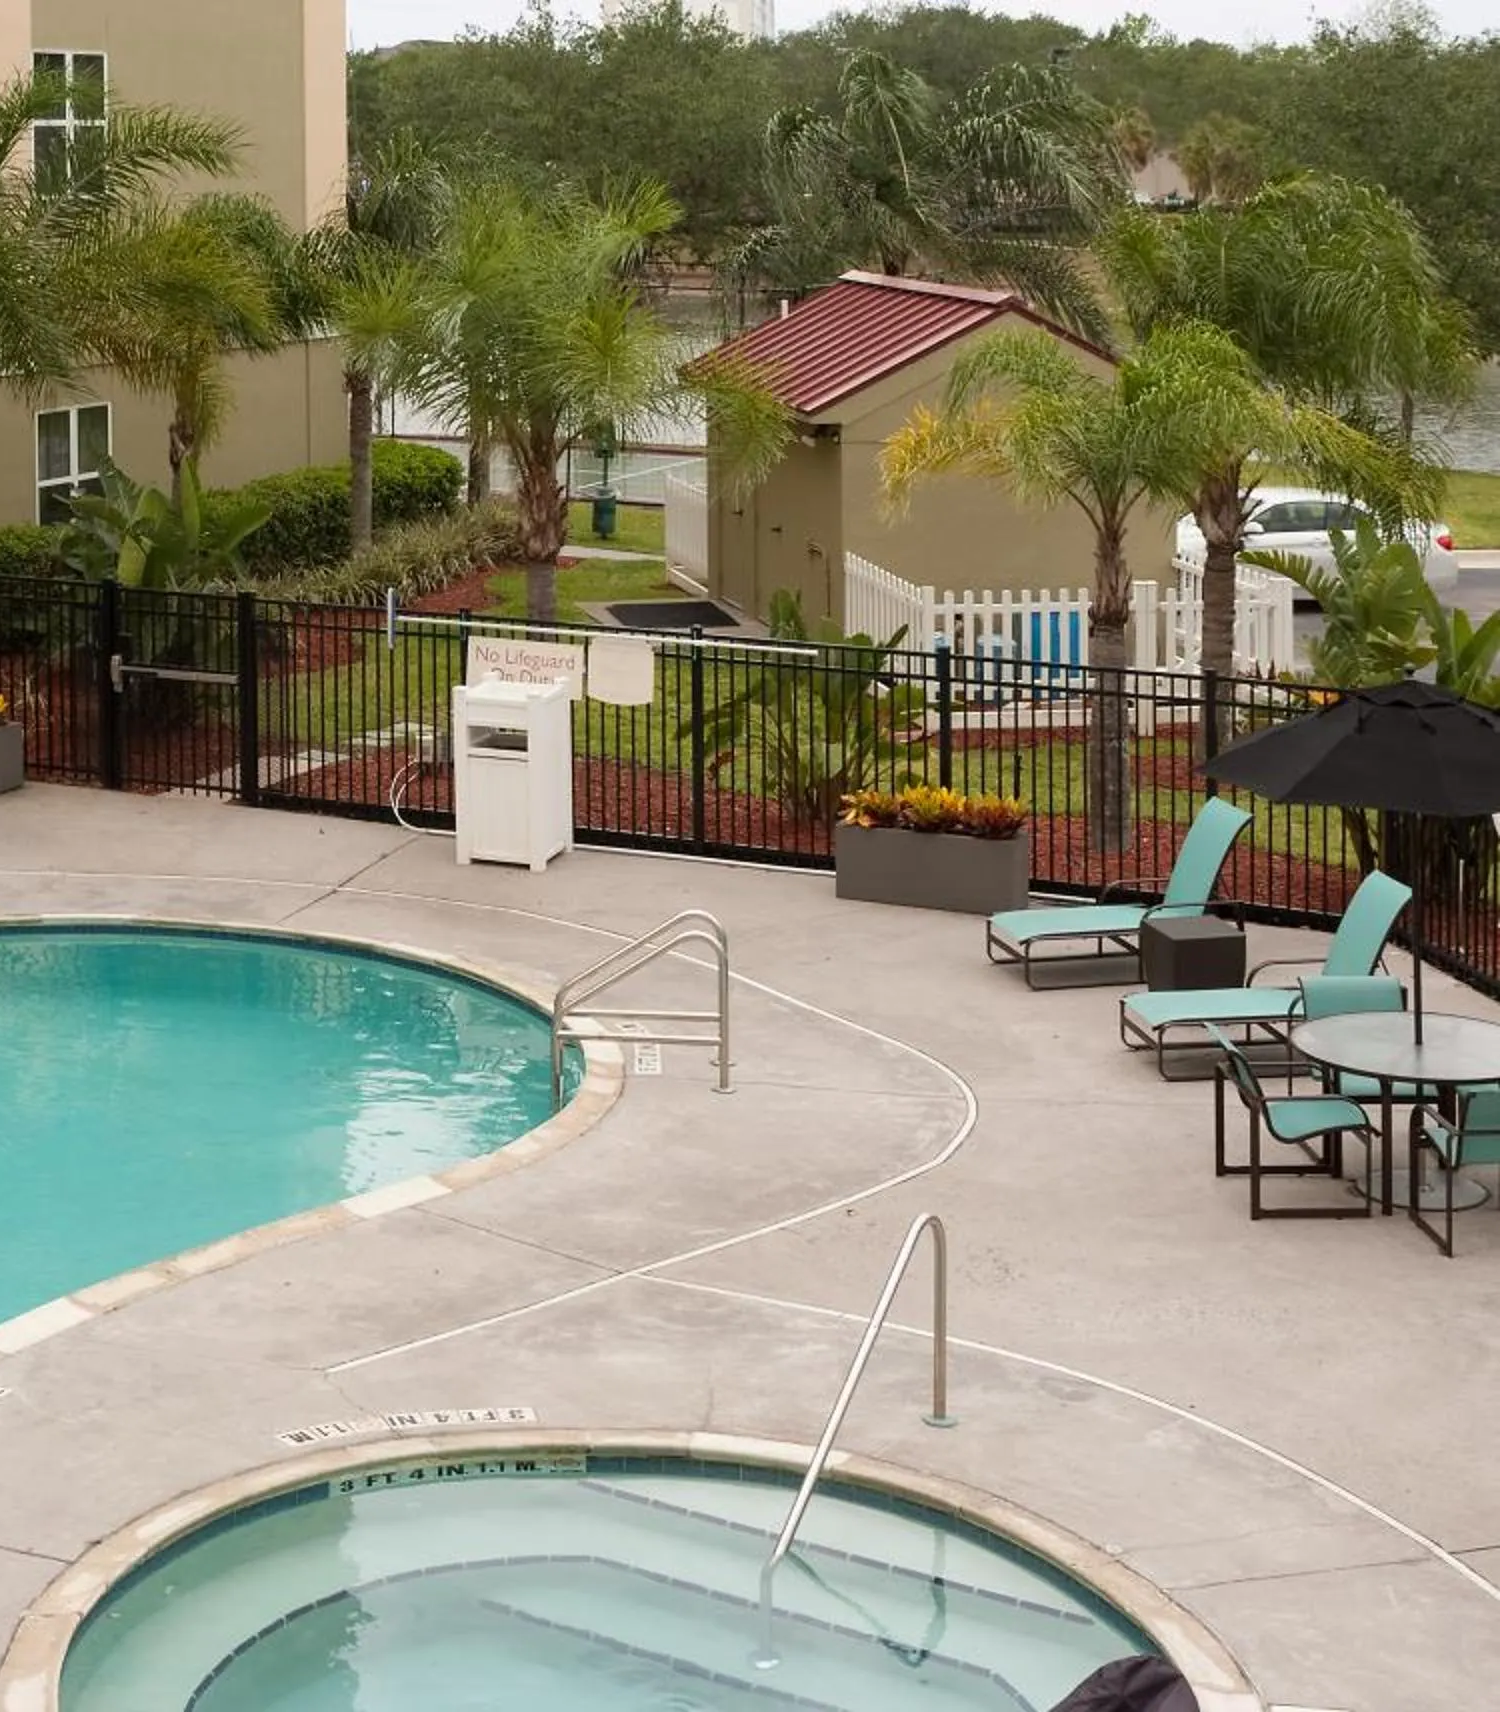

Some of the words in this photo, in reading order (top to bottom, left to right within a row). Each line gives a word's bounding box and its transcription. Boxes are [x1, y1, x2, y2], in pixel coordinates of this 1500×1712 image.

[475, 645, 500, 663] No
[505, 647, 575, 671] Lifeguard
[339, 1479, 354, 1493] 3
[409, 1468, 425, 1480] 4
